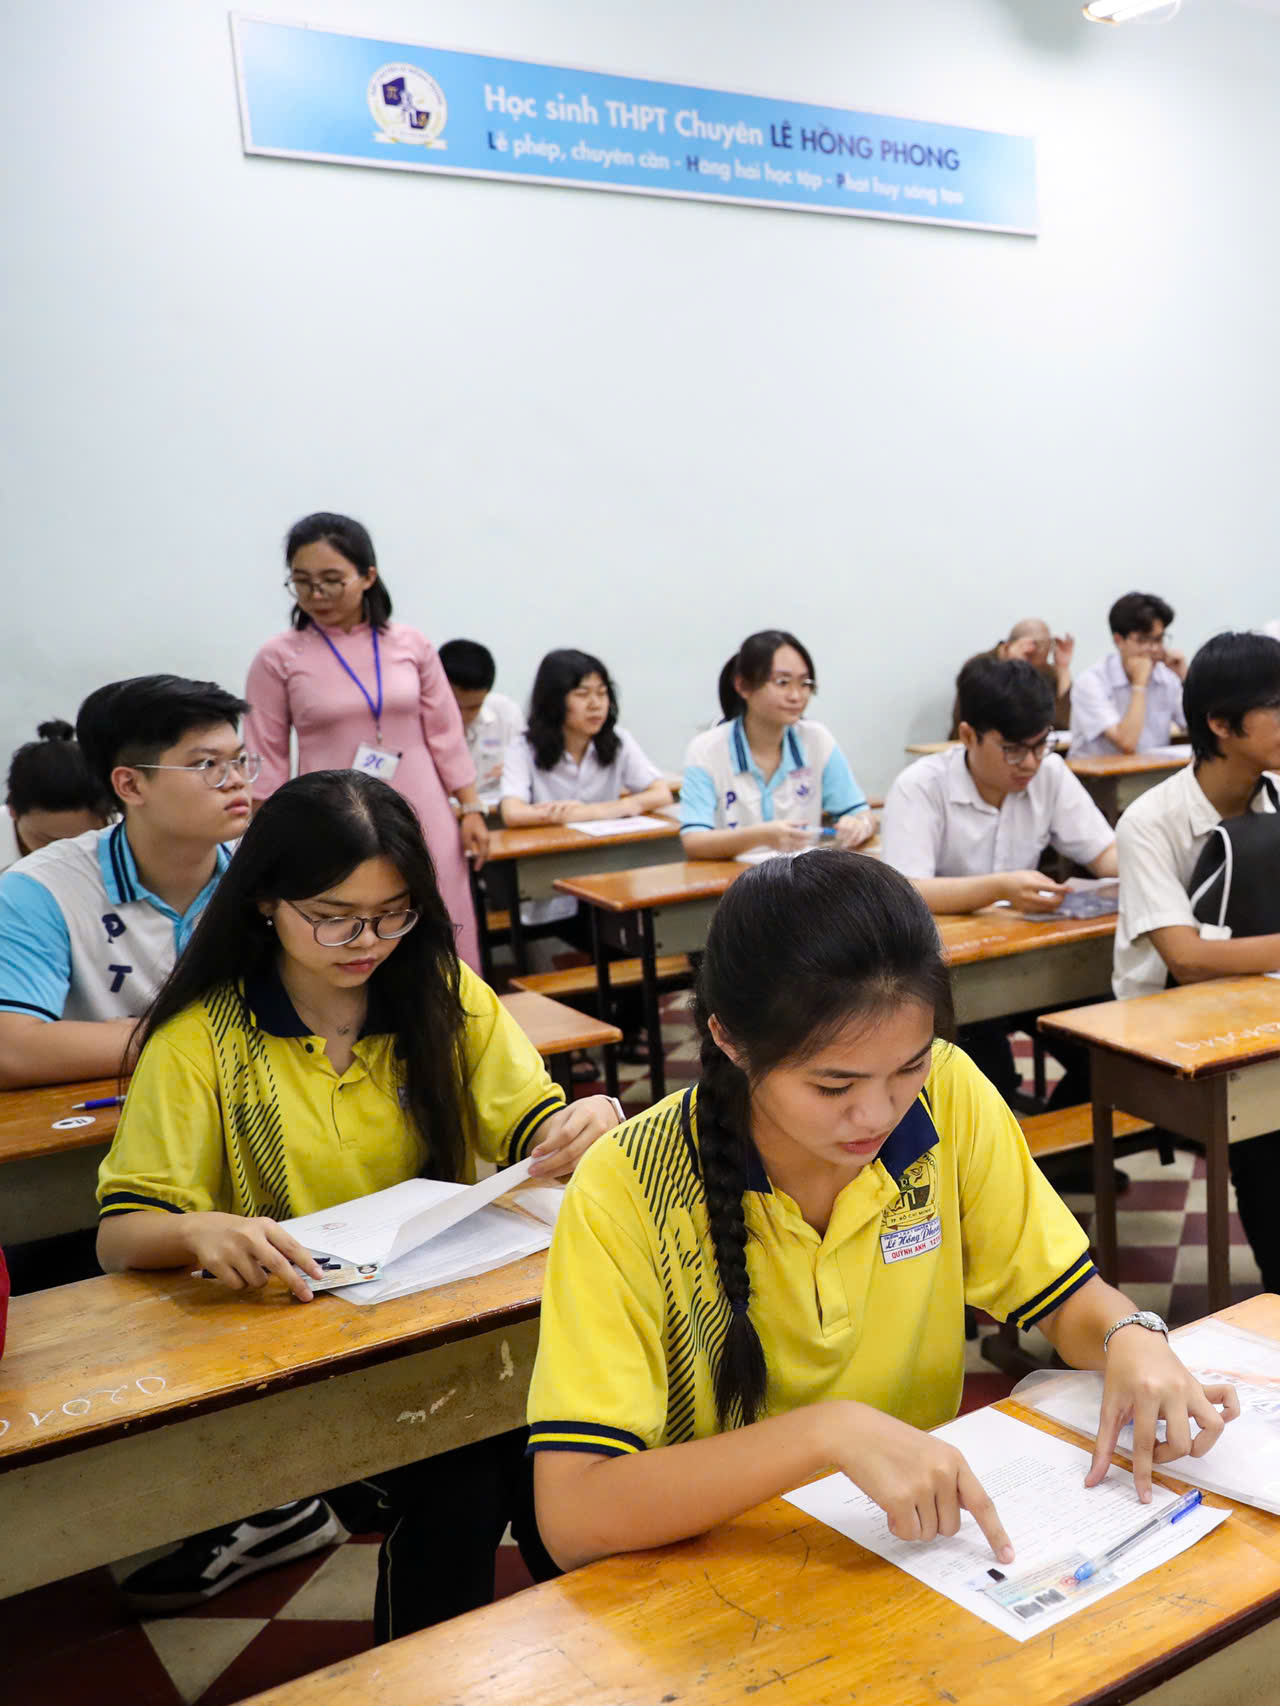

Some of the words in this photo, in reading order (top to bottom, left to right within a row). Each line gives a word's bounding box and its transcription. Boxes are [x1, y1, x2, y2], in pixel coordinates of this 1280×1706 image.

[484, 83, 538, 122] Học
[545, 92, 600, 126] sinh
[604, 99, 668, 135] THPT
[674, 108, 764, 150] Chuyên
[770, 120, 793, 149] LÊ
[800, 122, 873, 160] HỒNG
[880, 138, 960, 171] PHONG
